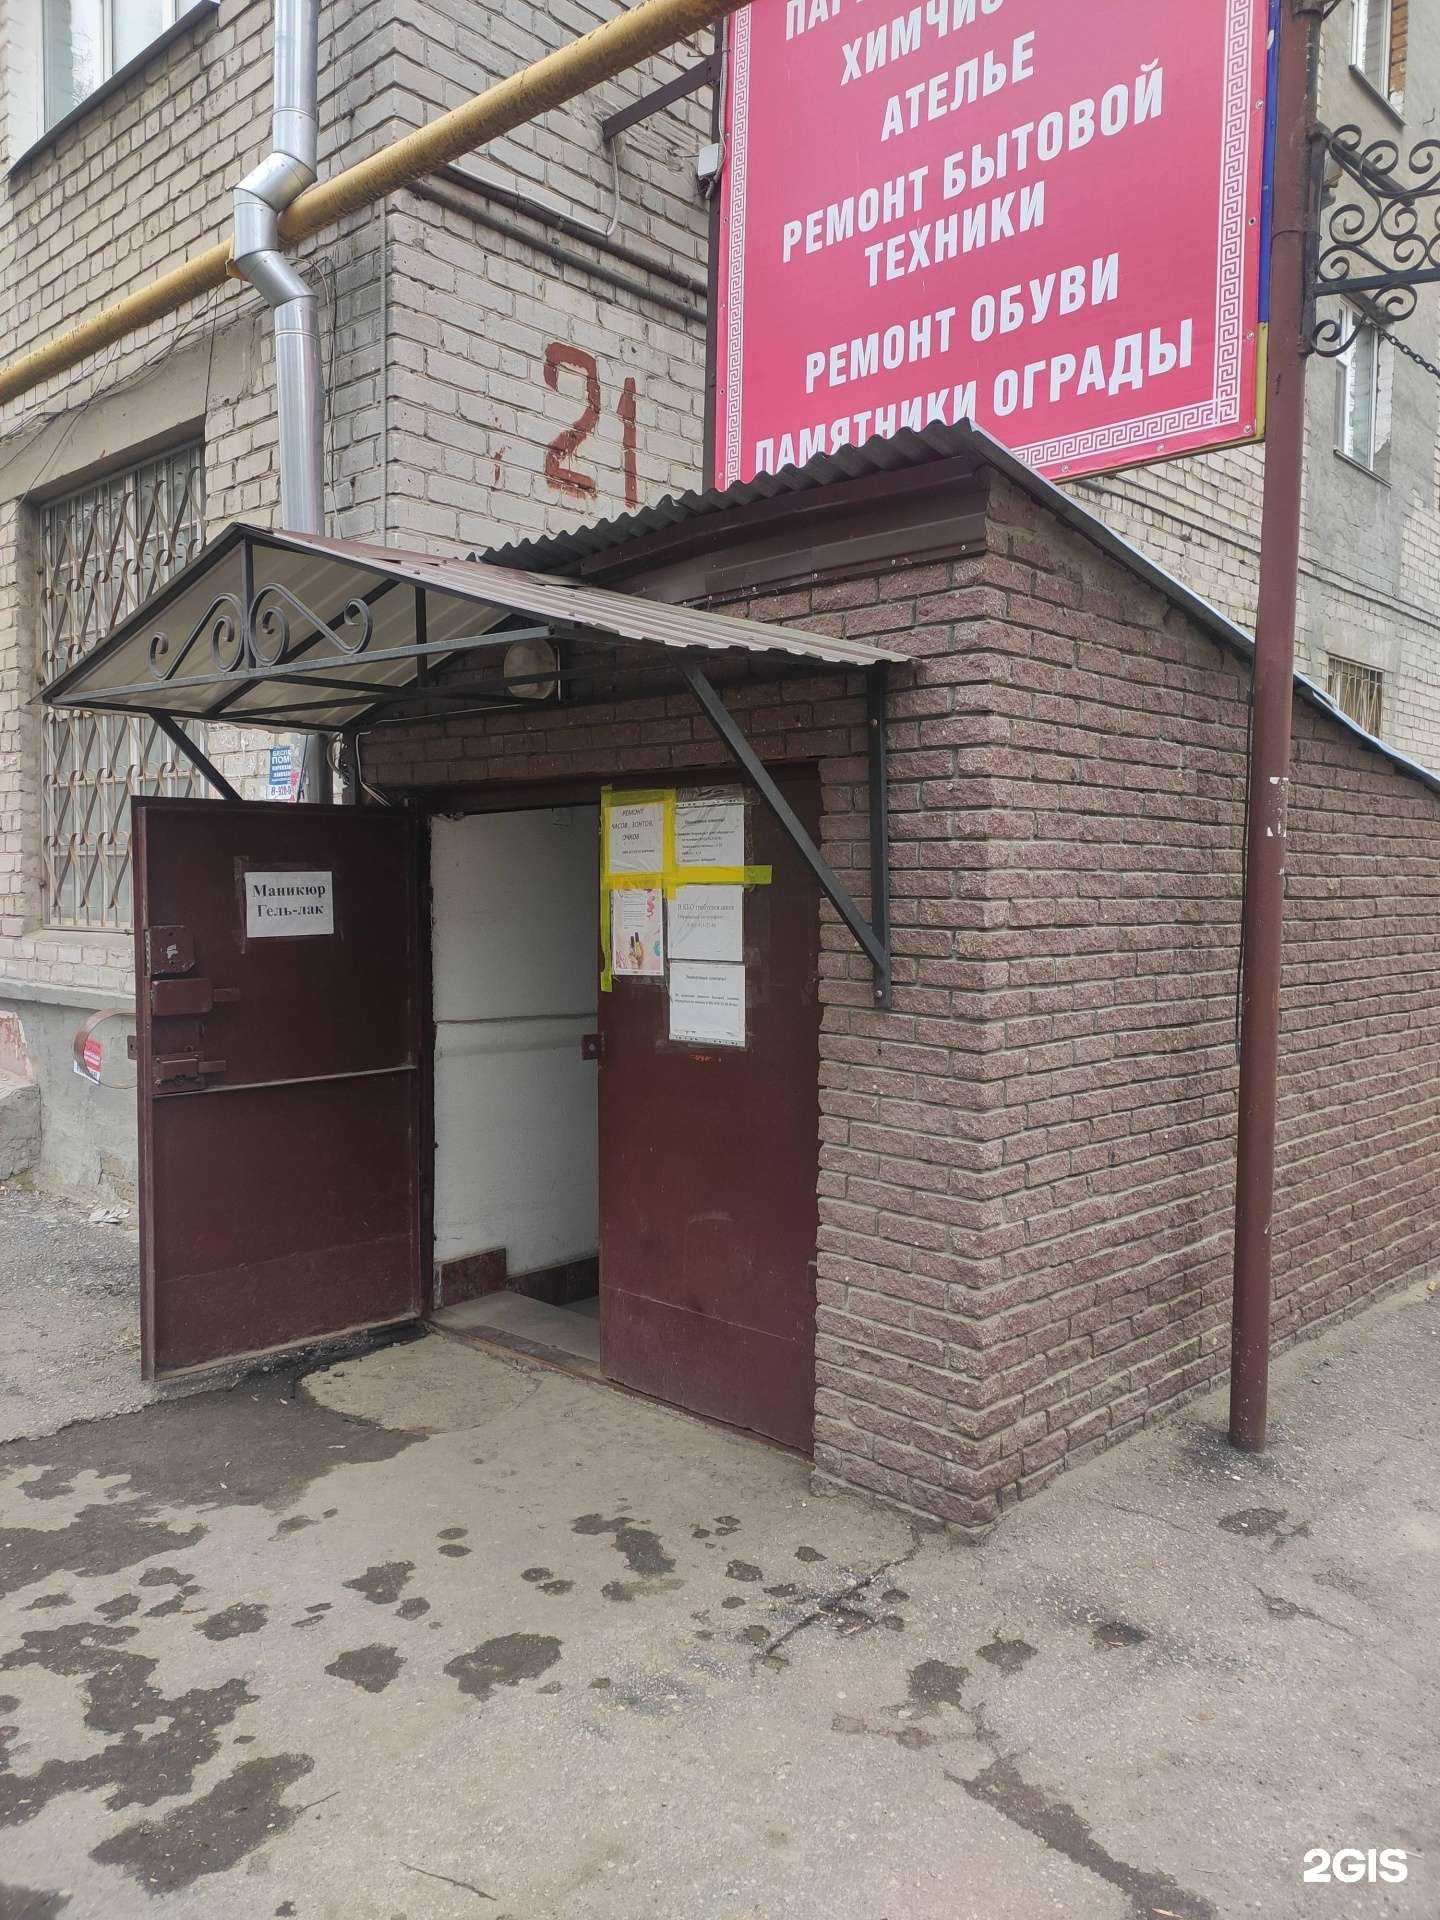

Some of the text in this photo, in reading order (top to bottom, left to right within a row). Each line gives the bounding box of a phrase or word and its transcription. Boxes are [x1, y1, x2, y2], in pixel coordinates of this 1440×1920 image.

[880, 31, 1035, 142] АТЕЛЬЕ
[781, 57, 1163, 264] РЕМОНТ БЫТОВОЙ
[864, 180, 1046, 288] ТЕХНИКИ
[805, 252, 1120, 394] РЕМОНТ ОБУВИ
[543, 341, 637, 509] 21
[755, 318, 1194, 476] ПАМЯТНИКИ ОГРАДЫ
[252, 884, 326, 898] Маникюр
[256, 904, 325, 918] Гель-лак
